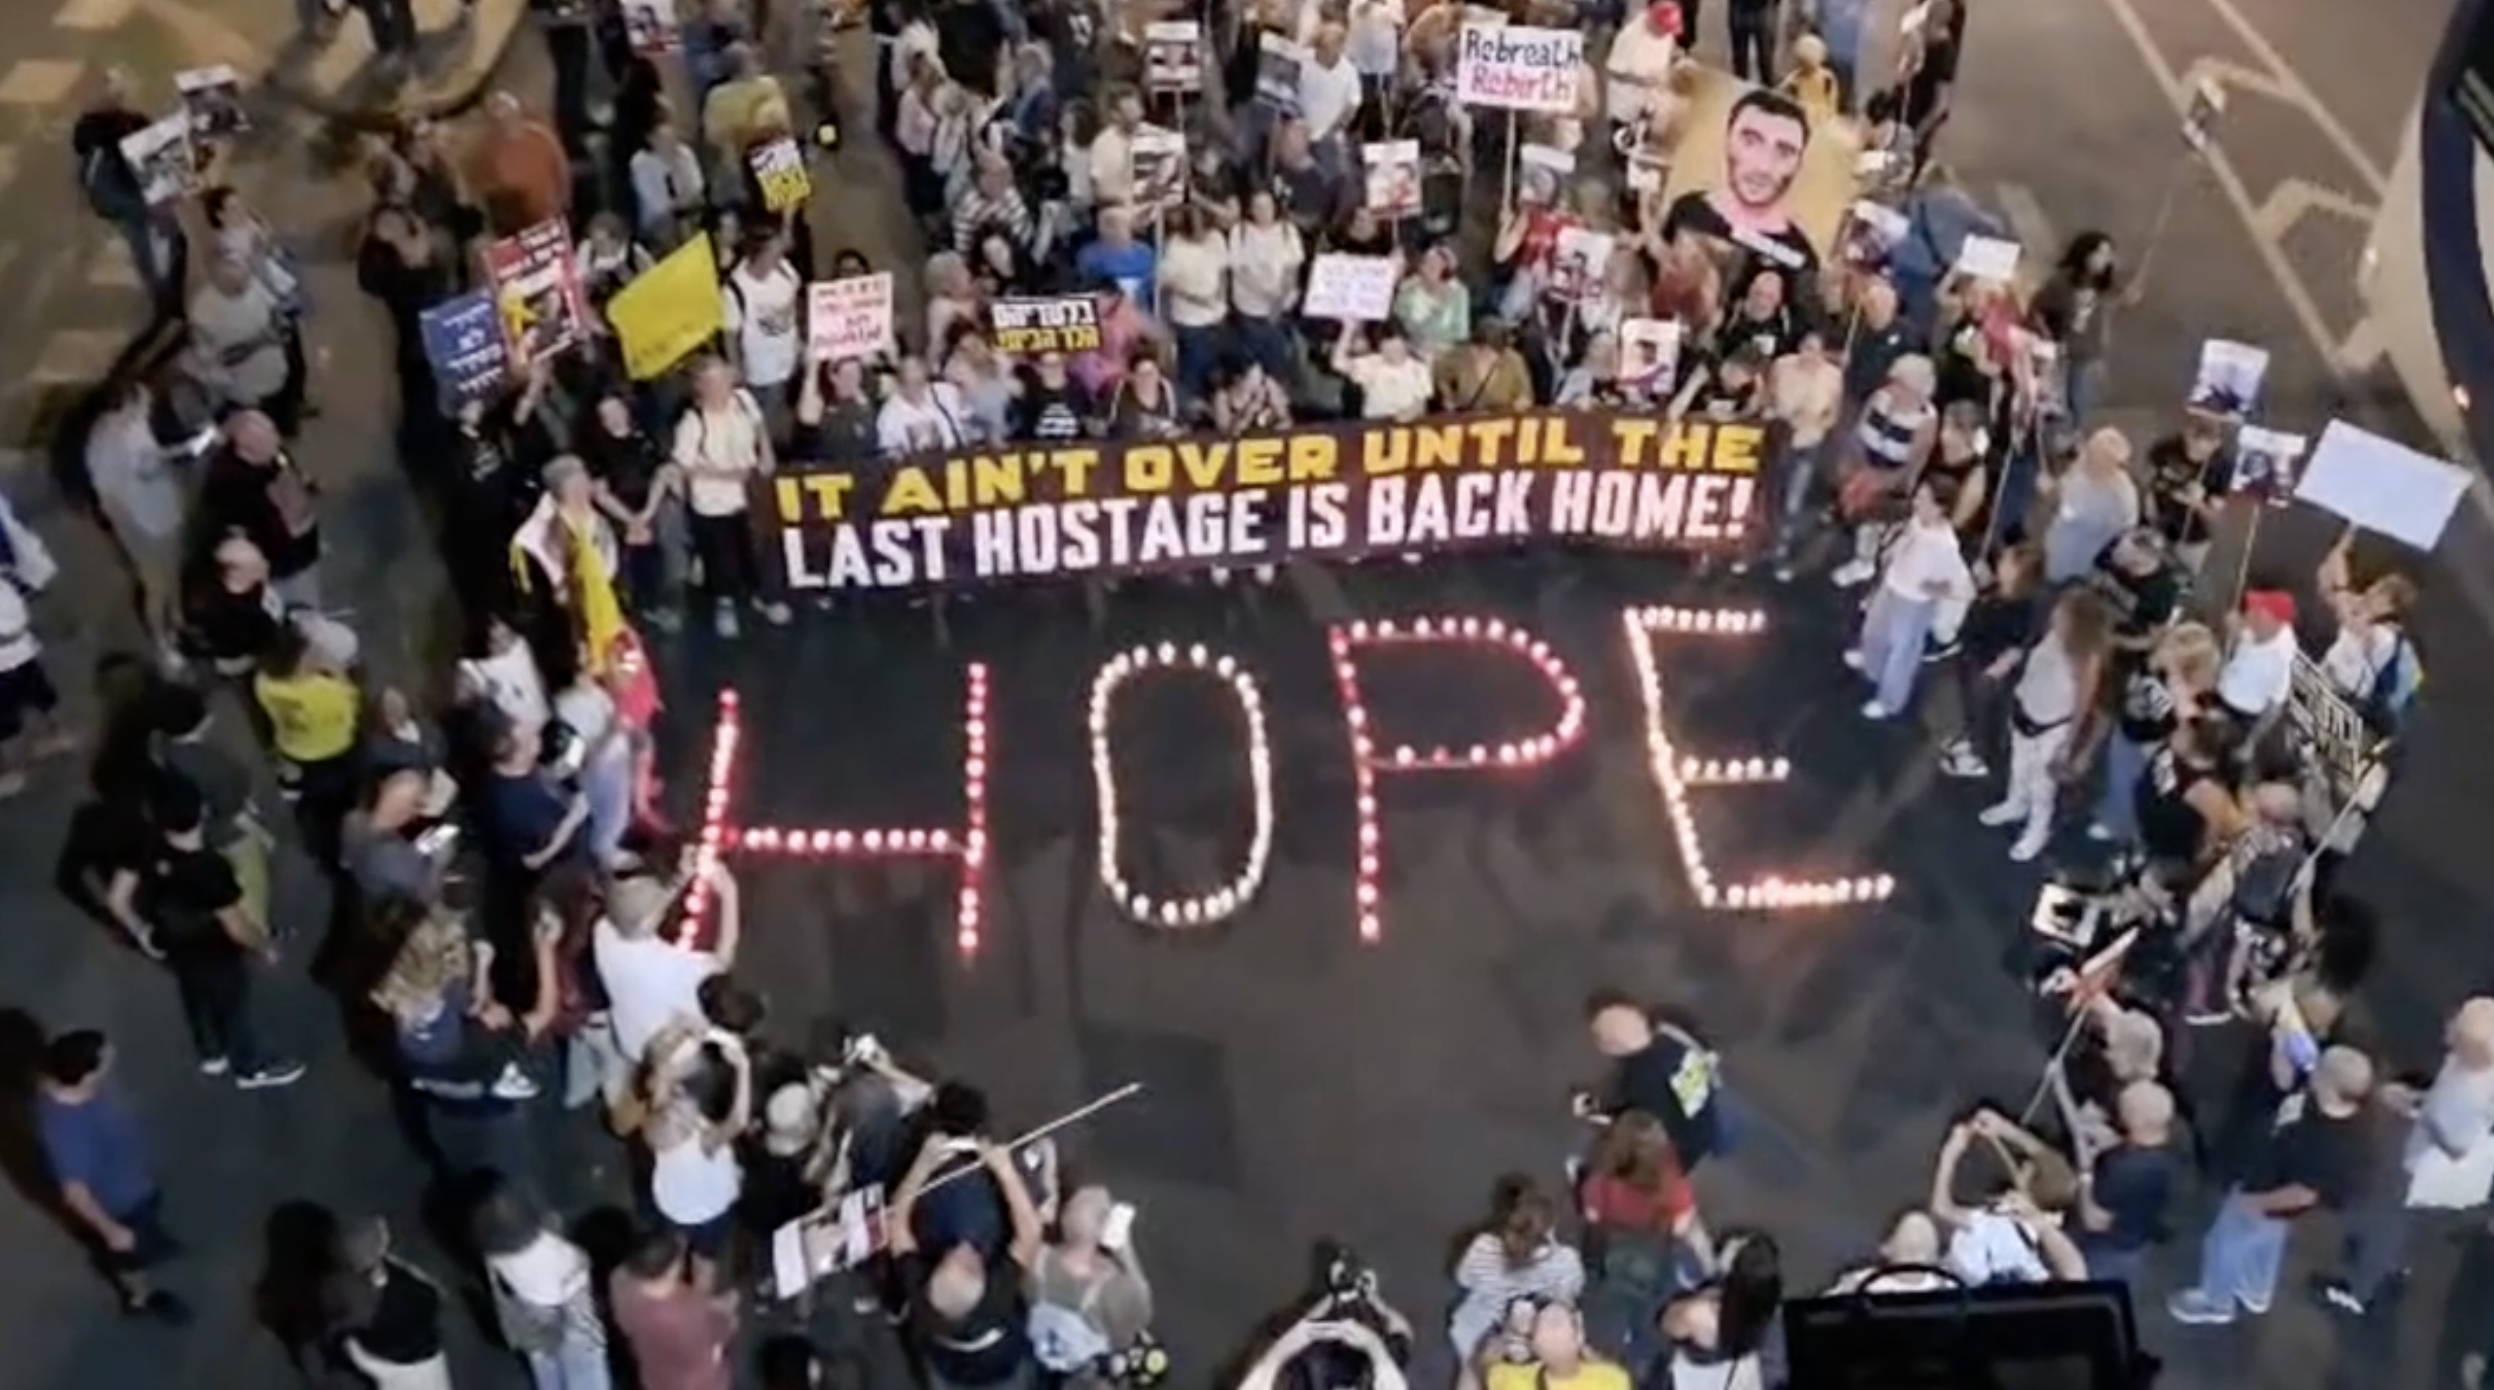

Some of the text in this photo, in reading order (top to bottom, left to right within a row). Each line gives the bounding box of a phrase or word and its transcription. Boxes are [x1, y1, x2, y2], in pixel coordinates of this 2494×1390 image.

[1466, 28, 1579, 70] Rebreath
[1471, 64, 1571, 102] Rebirth
[776, 418, 1766, 523] IT AIN'T OVER UNTIL THE
[780, 468, 1754, 589] LAST HOSTAGE IS BACK HOME!
[678, 604, 1896, 957] HOPE
